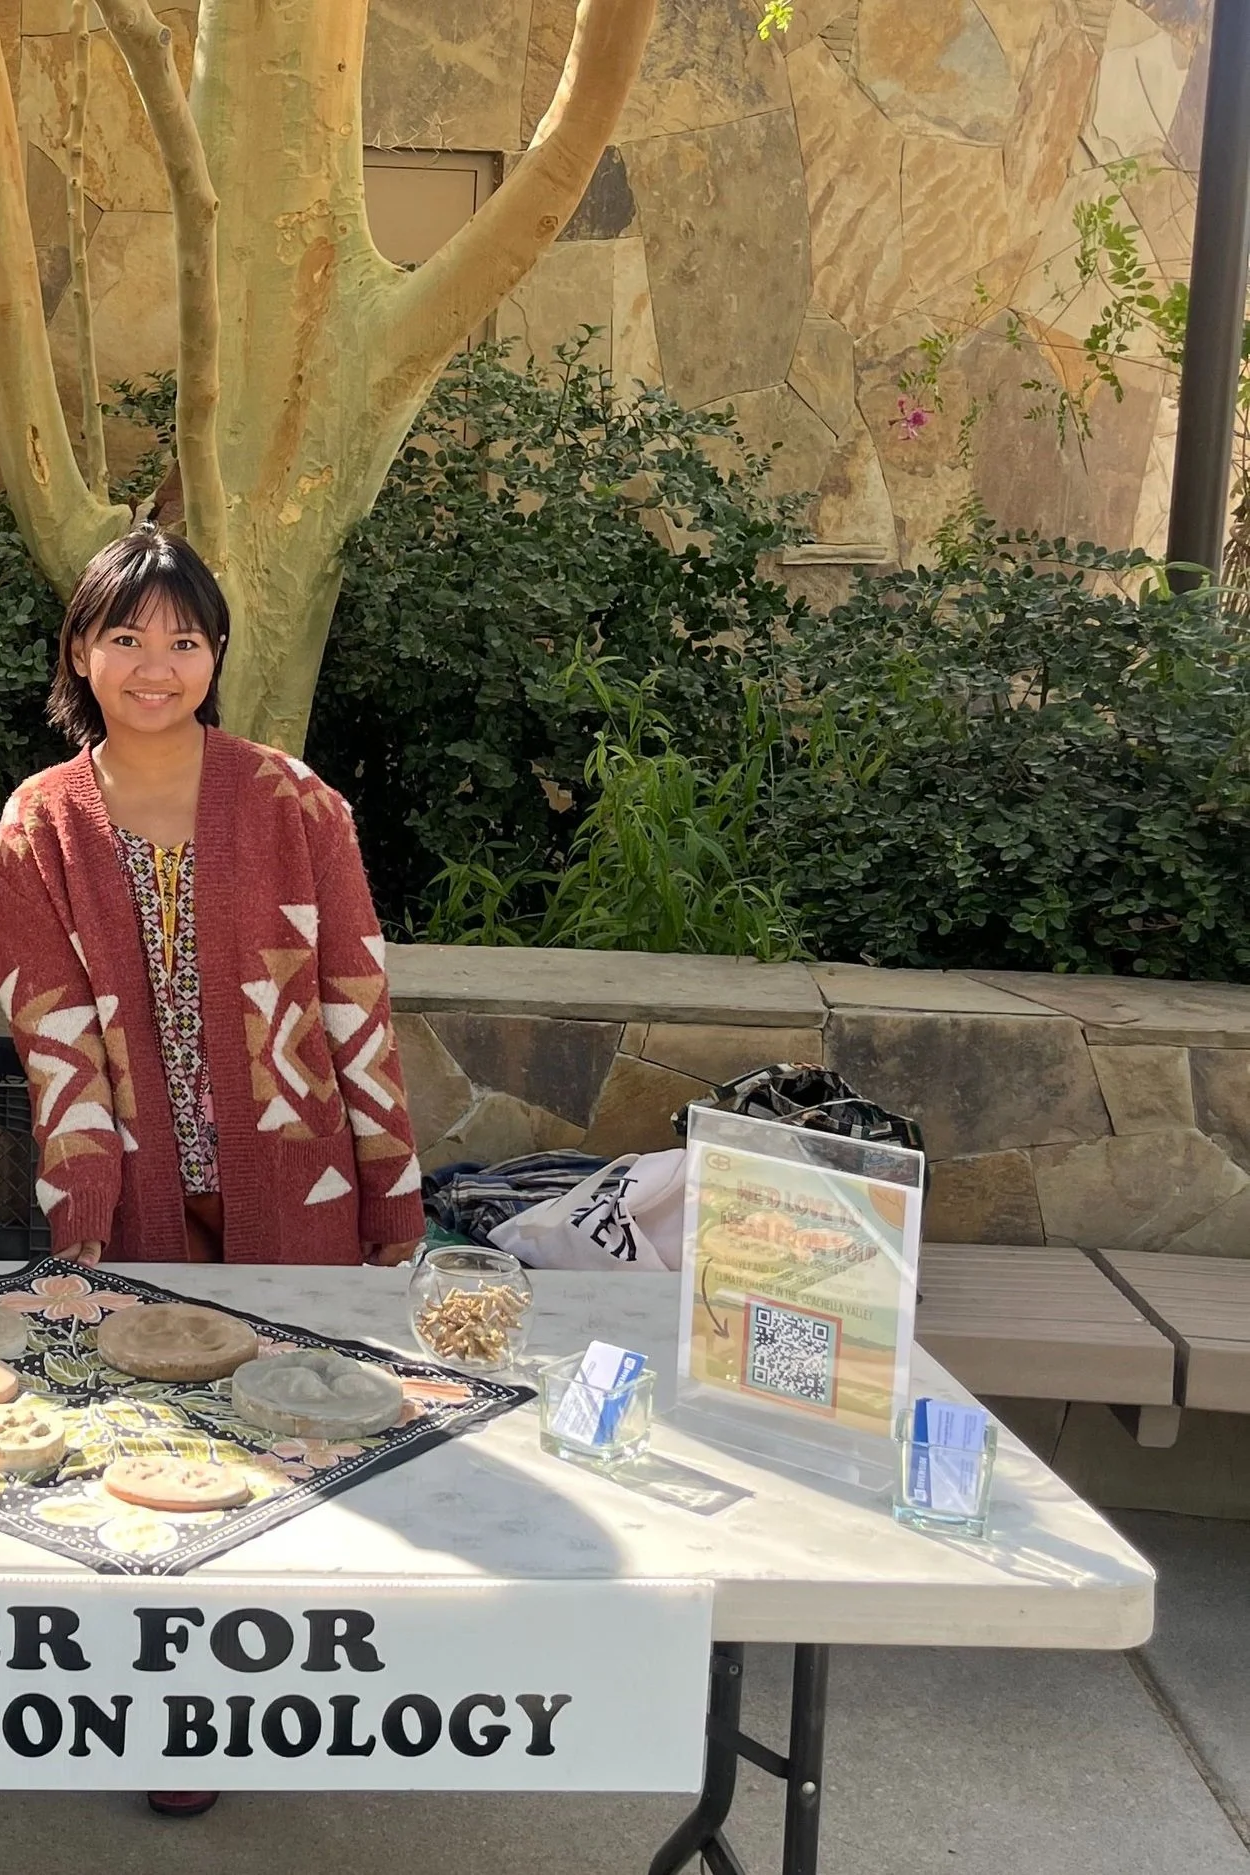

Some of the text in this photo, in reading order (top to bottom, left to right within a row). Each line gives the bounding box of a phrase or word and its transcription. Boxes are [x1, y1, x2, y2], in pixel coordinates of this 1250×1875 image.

[784, 1190, 833, 1221] LOVE
[715, 1271, 874, 1320] CLIMATE CHANGE IN THE COACHELLA VALLEY
[133, 1607, 386, 1673] FOR
[162, 1694, 572, 1758] BIOLOGY
